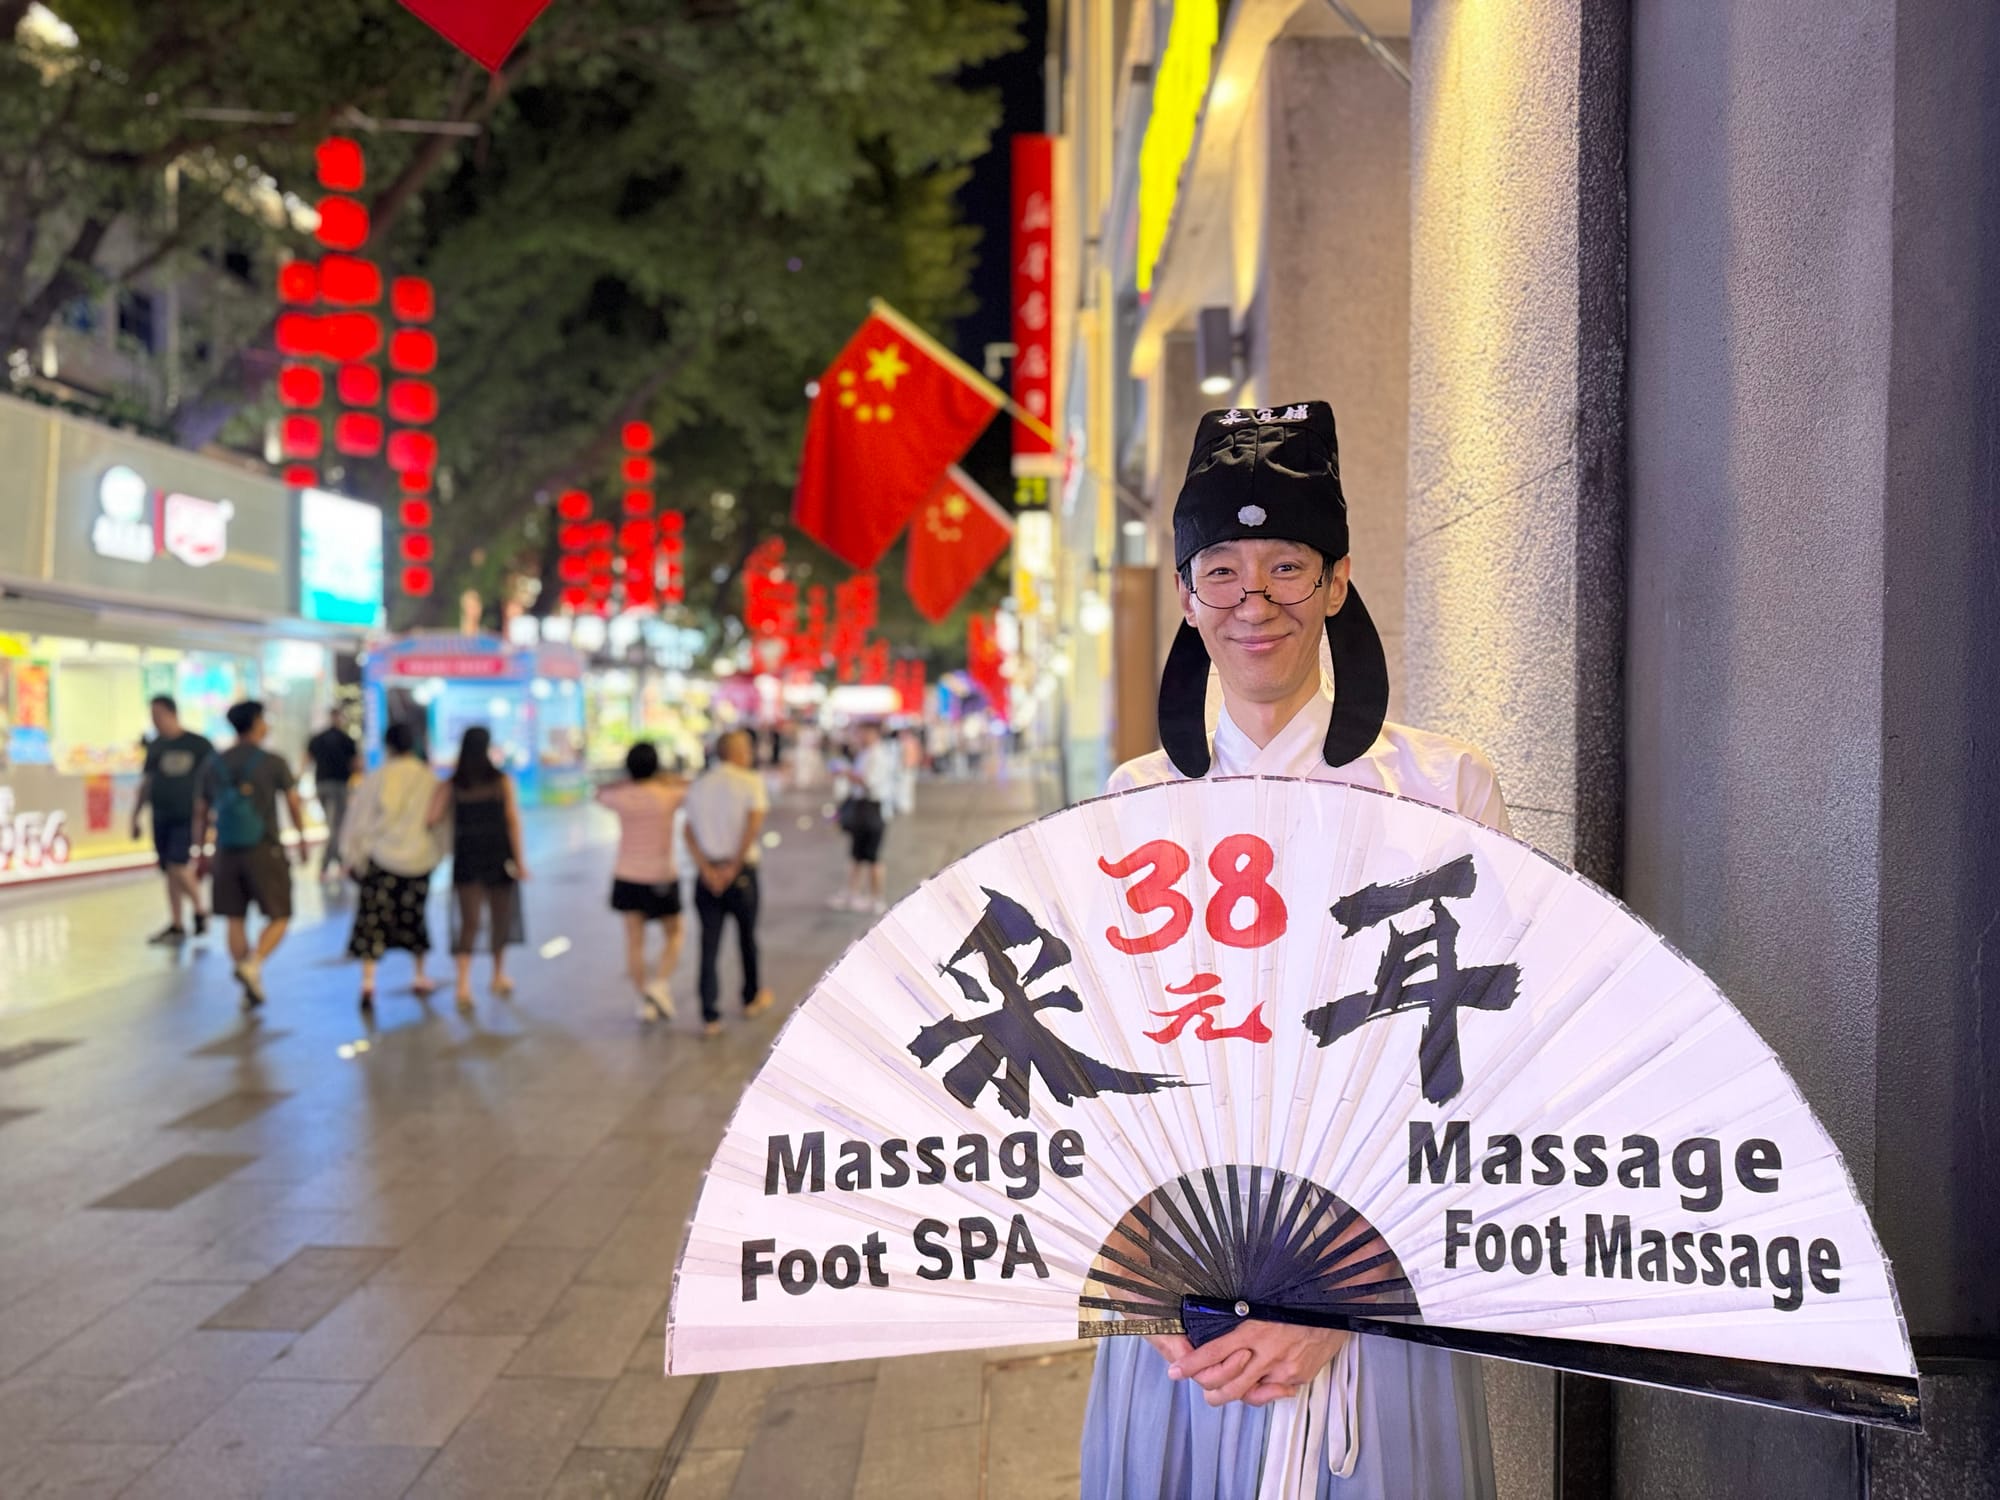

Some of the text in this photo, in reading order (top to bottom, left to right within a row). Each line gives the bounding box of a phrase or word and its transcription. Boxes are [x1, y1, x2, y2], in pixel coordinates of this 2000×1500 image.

[1097, 833, 1289, 956] 38
[906, 853, 1523, 1120] 采 耳
[1143, 972, 1274, 1045] 元
[764, 1128, 1086, 1200] Massage
[1406, 1119, 1783, 1213] Massage
[741, 1213, 1051, 1302] Foot SPA
[1444, 1209, 1842, 1313] Foot Massage
